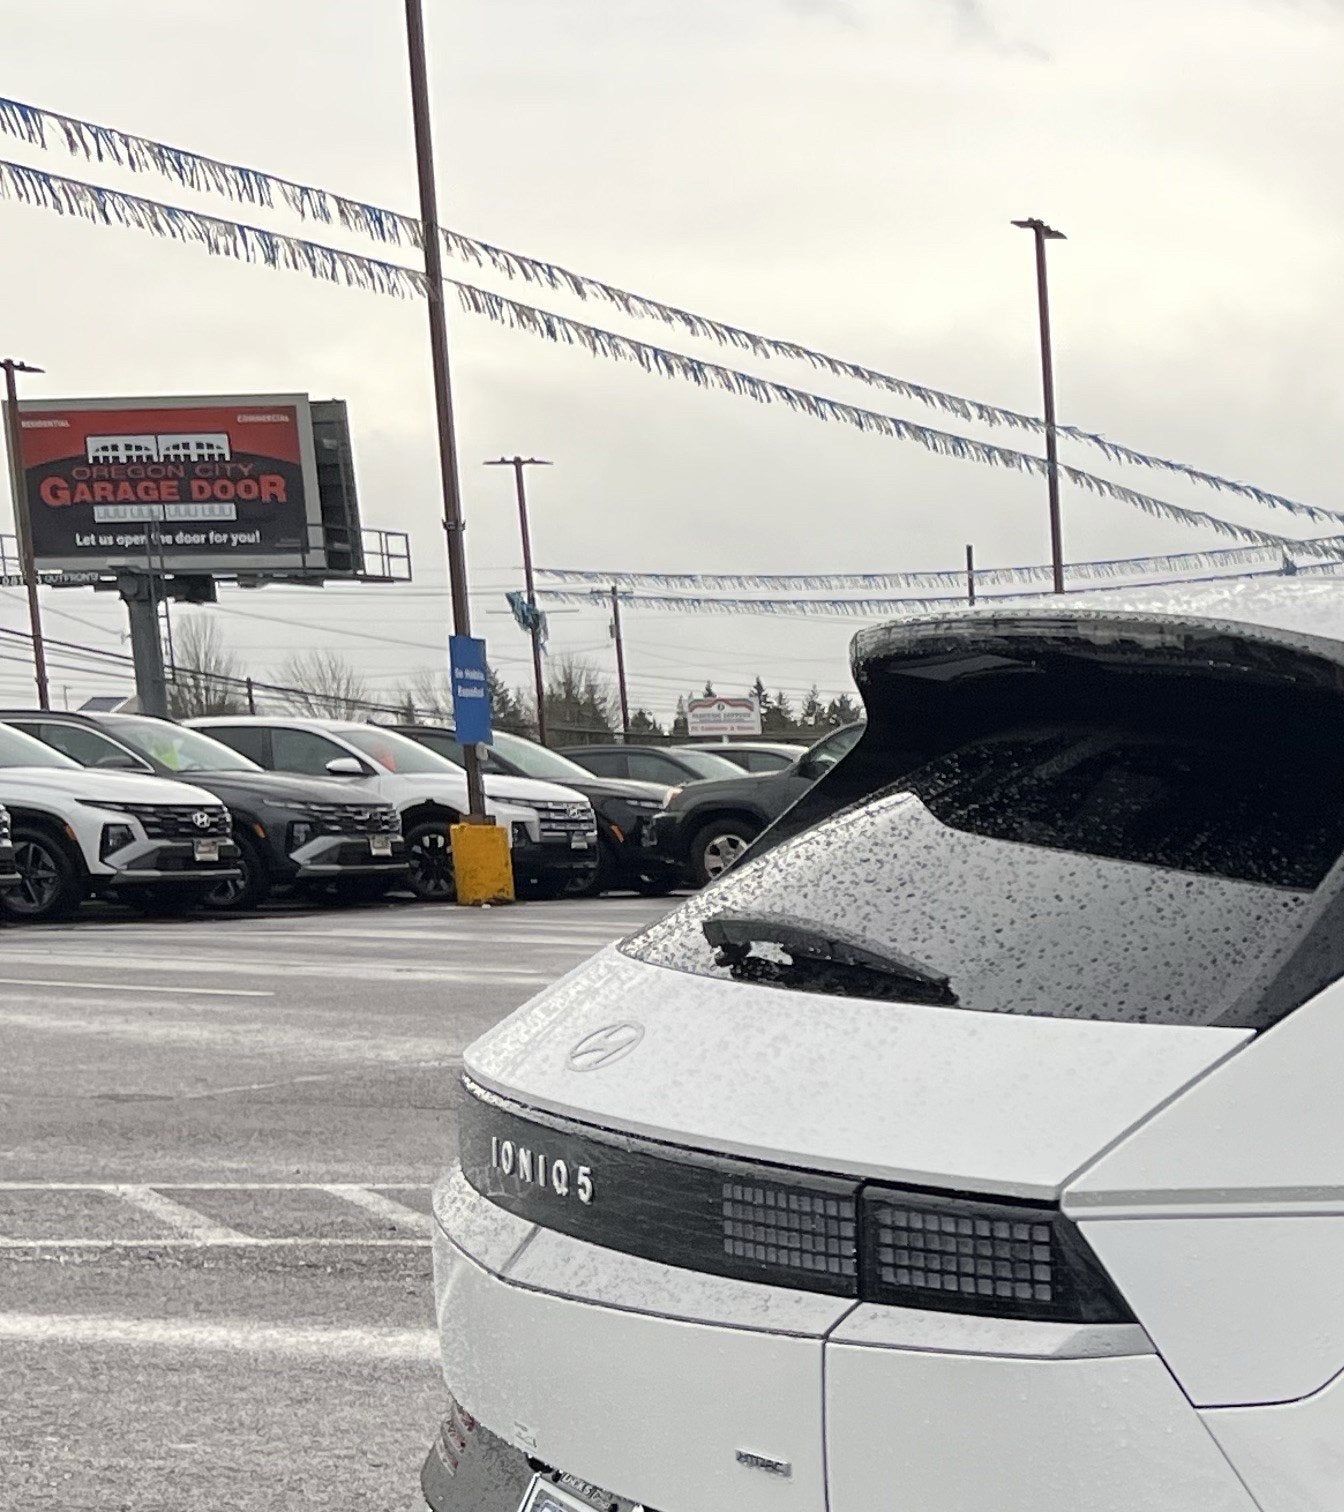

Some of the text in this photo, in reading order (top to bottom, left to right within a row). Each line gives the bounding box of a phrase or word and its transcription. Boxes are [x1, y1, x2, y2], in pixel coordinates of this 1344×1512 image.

[72, 463, 255, 480] OREGON CITY
[39, 474, 288, 507] GARAGE DOOR
[75, 532, 96, 546] Let
[99, 535, 114, 546] us
[175, 530, 206, 546] door
[209, 530, 228, 544] for
[230, 530, 261, 547] you!
[491, 1136, 593, 1205] IONIQ 5
